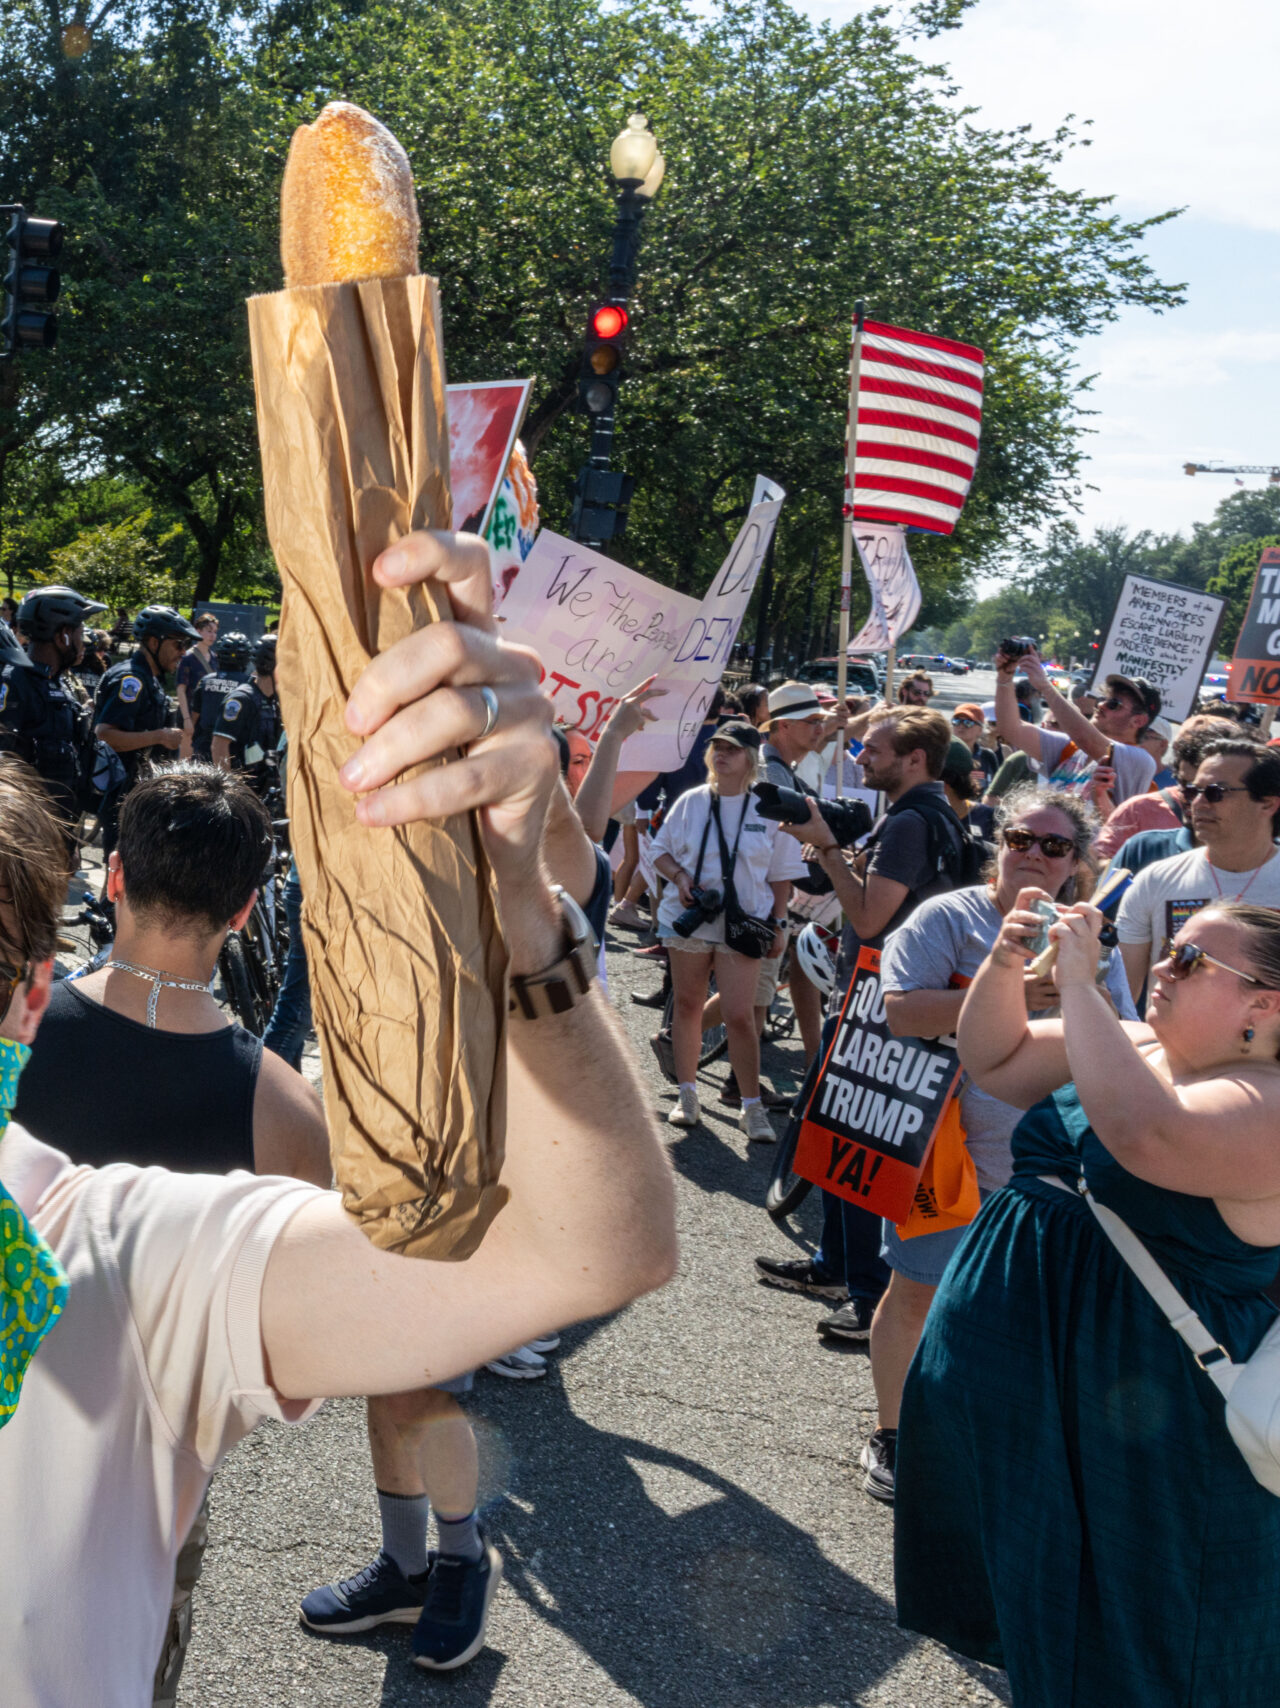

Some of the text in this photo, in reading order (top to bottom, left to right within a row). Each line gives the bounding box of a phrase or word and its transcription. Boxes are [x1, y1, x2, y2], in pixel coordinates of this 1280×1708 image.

[546, 554, 597, 618] We
[606, 597, 643, 634] the
[1128, 596, 1205, 627] ARMED FORCES
[1140, 611, 1189, 631] CANNOT
[1114, 637, 1156, 657] ORDERS
[1120, 617, 1205, 646] ESCAPE LIABILITY
[1131, 632, 1189, 654] OBEDIENCE
[564, 638, 633, 688] are
[1115, 652, 1188, 677] MANIFESTLY
[831, 1024, 950, 1100] LARGUE
[820, 1073, 924, 1147] TRUMP
[824, 1136, 884, 1197] YA!
